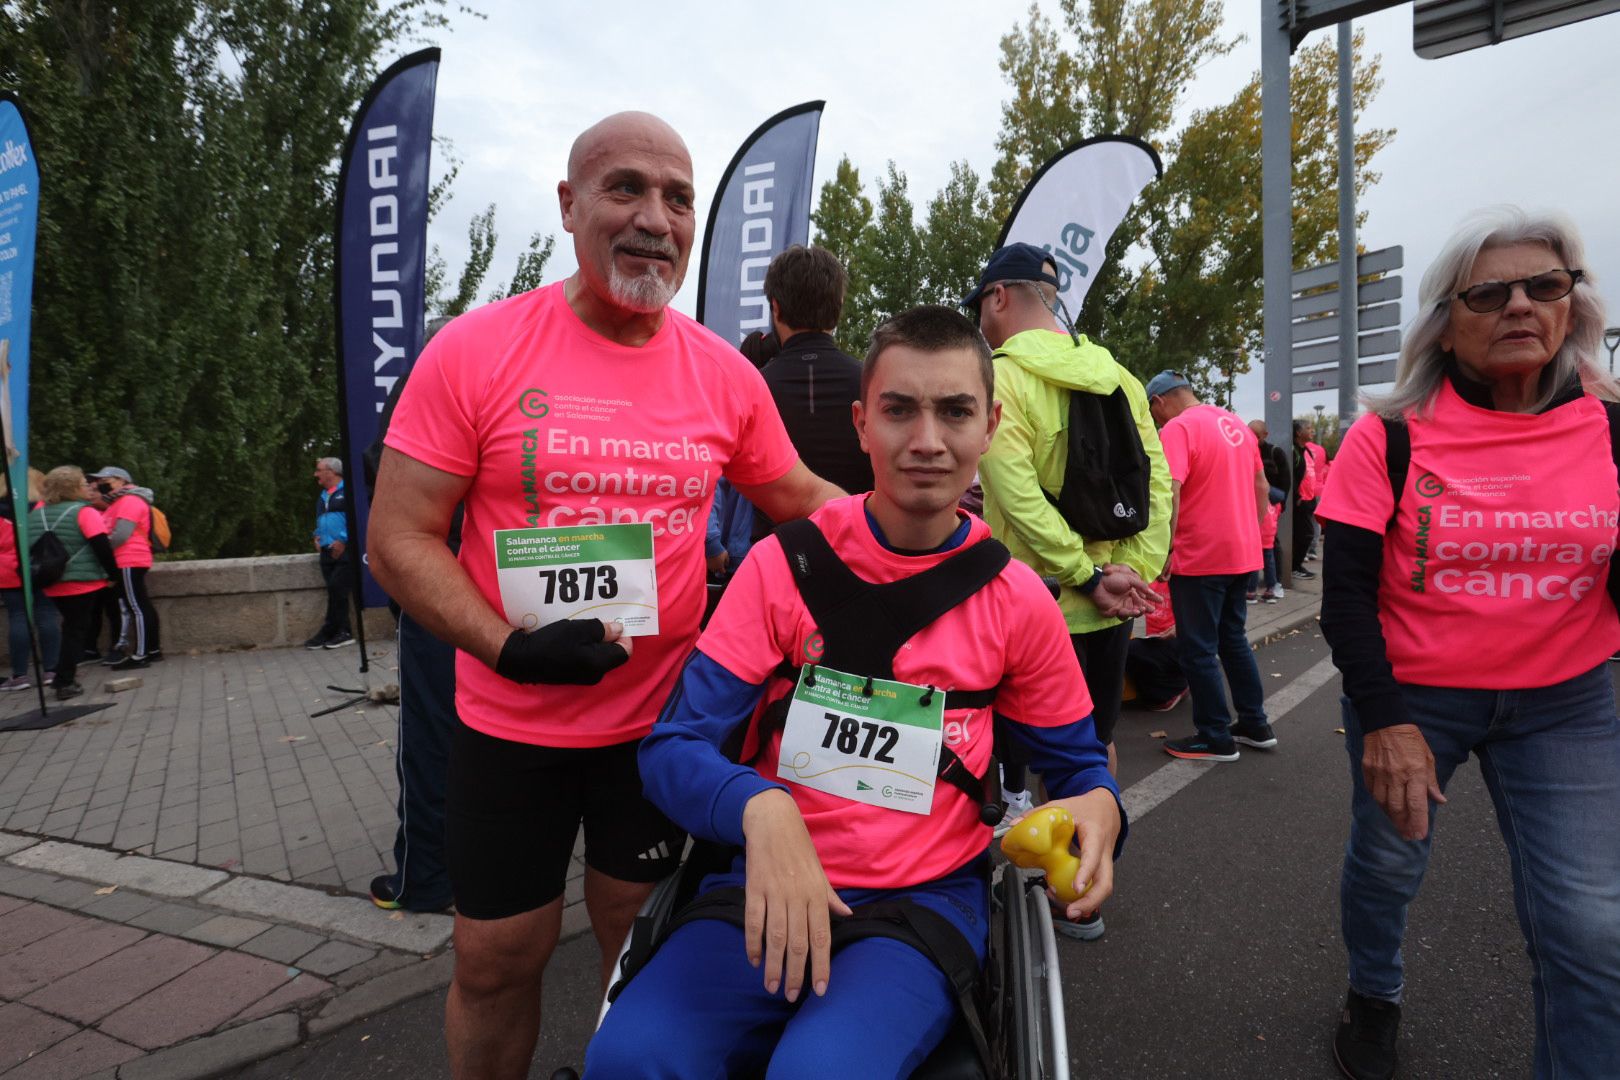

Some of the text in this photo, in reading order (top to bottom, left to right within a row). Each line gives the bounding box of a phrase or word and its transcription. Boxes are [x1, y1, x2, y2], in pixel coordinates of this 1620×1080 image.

[367, 124, 406, 413] HYUNDAI
[739, 161, 776, 343] UNDAI
[1043, 222, 1096, 314] aja
[547, 428, 713, 463] En marcha
[521, 427, 542, 528] ALAMANCA
[544, 467, 709, 498] contra el
[547, 496, 699, 537] cáncer
[1439, 504, 1619, 529] En marcha
[506, 536, 557, 546] Salamanca
[571, 533, 605, 542] marcha
[506, 544, 580, 556] contra el cáncer
[1410, 504, 1433, 593] SALAMANCA
[1434, 535, 1617, 566] contra el
[539, 565, 619, 604] 7873
[1433, 563, 1600, 602] cánce
[814, 674, 852, 691] alamanca
[872, 688, 897, 699] archa
[832, 690, 841, 698] el
[841, 692, 872, 705] cáncer
[821, 712, 900, 764] 7872
[943, 712, 972, 746] el
